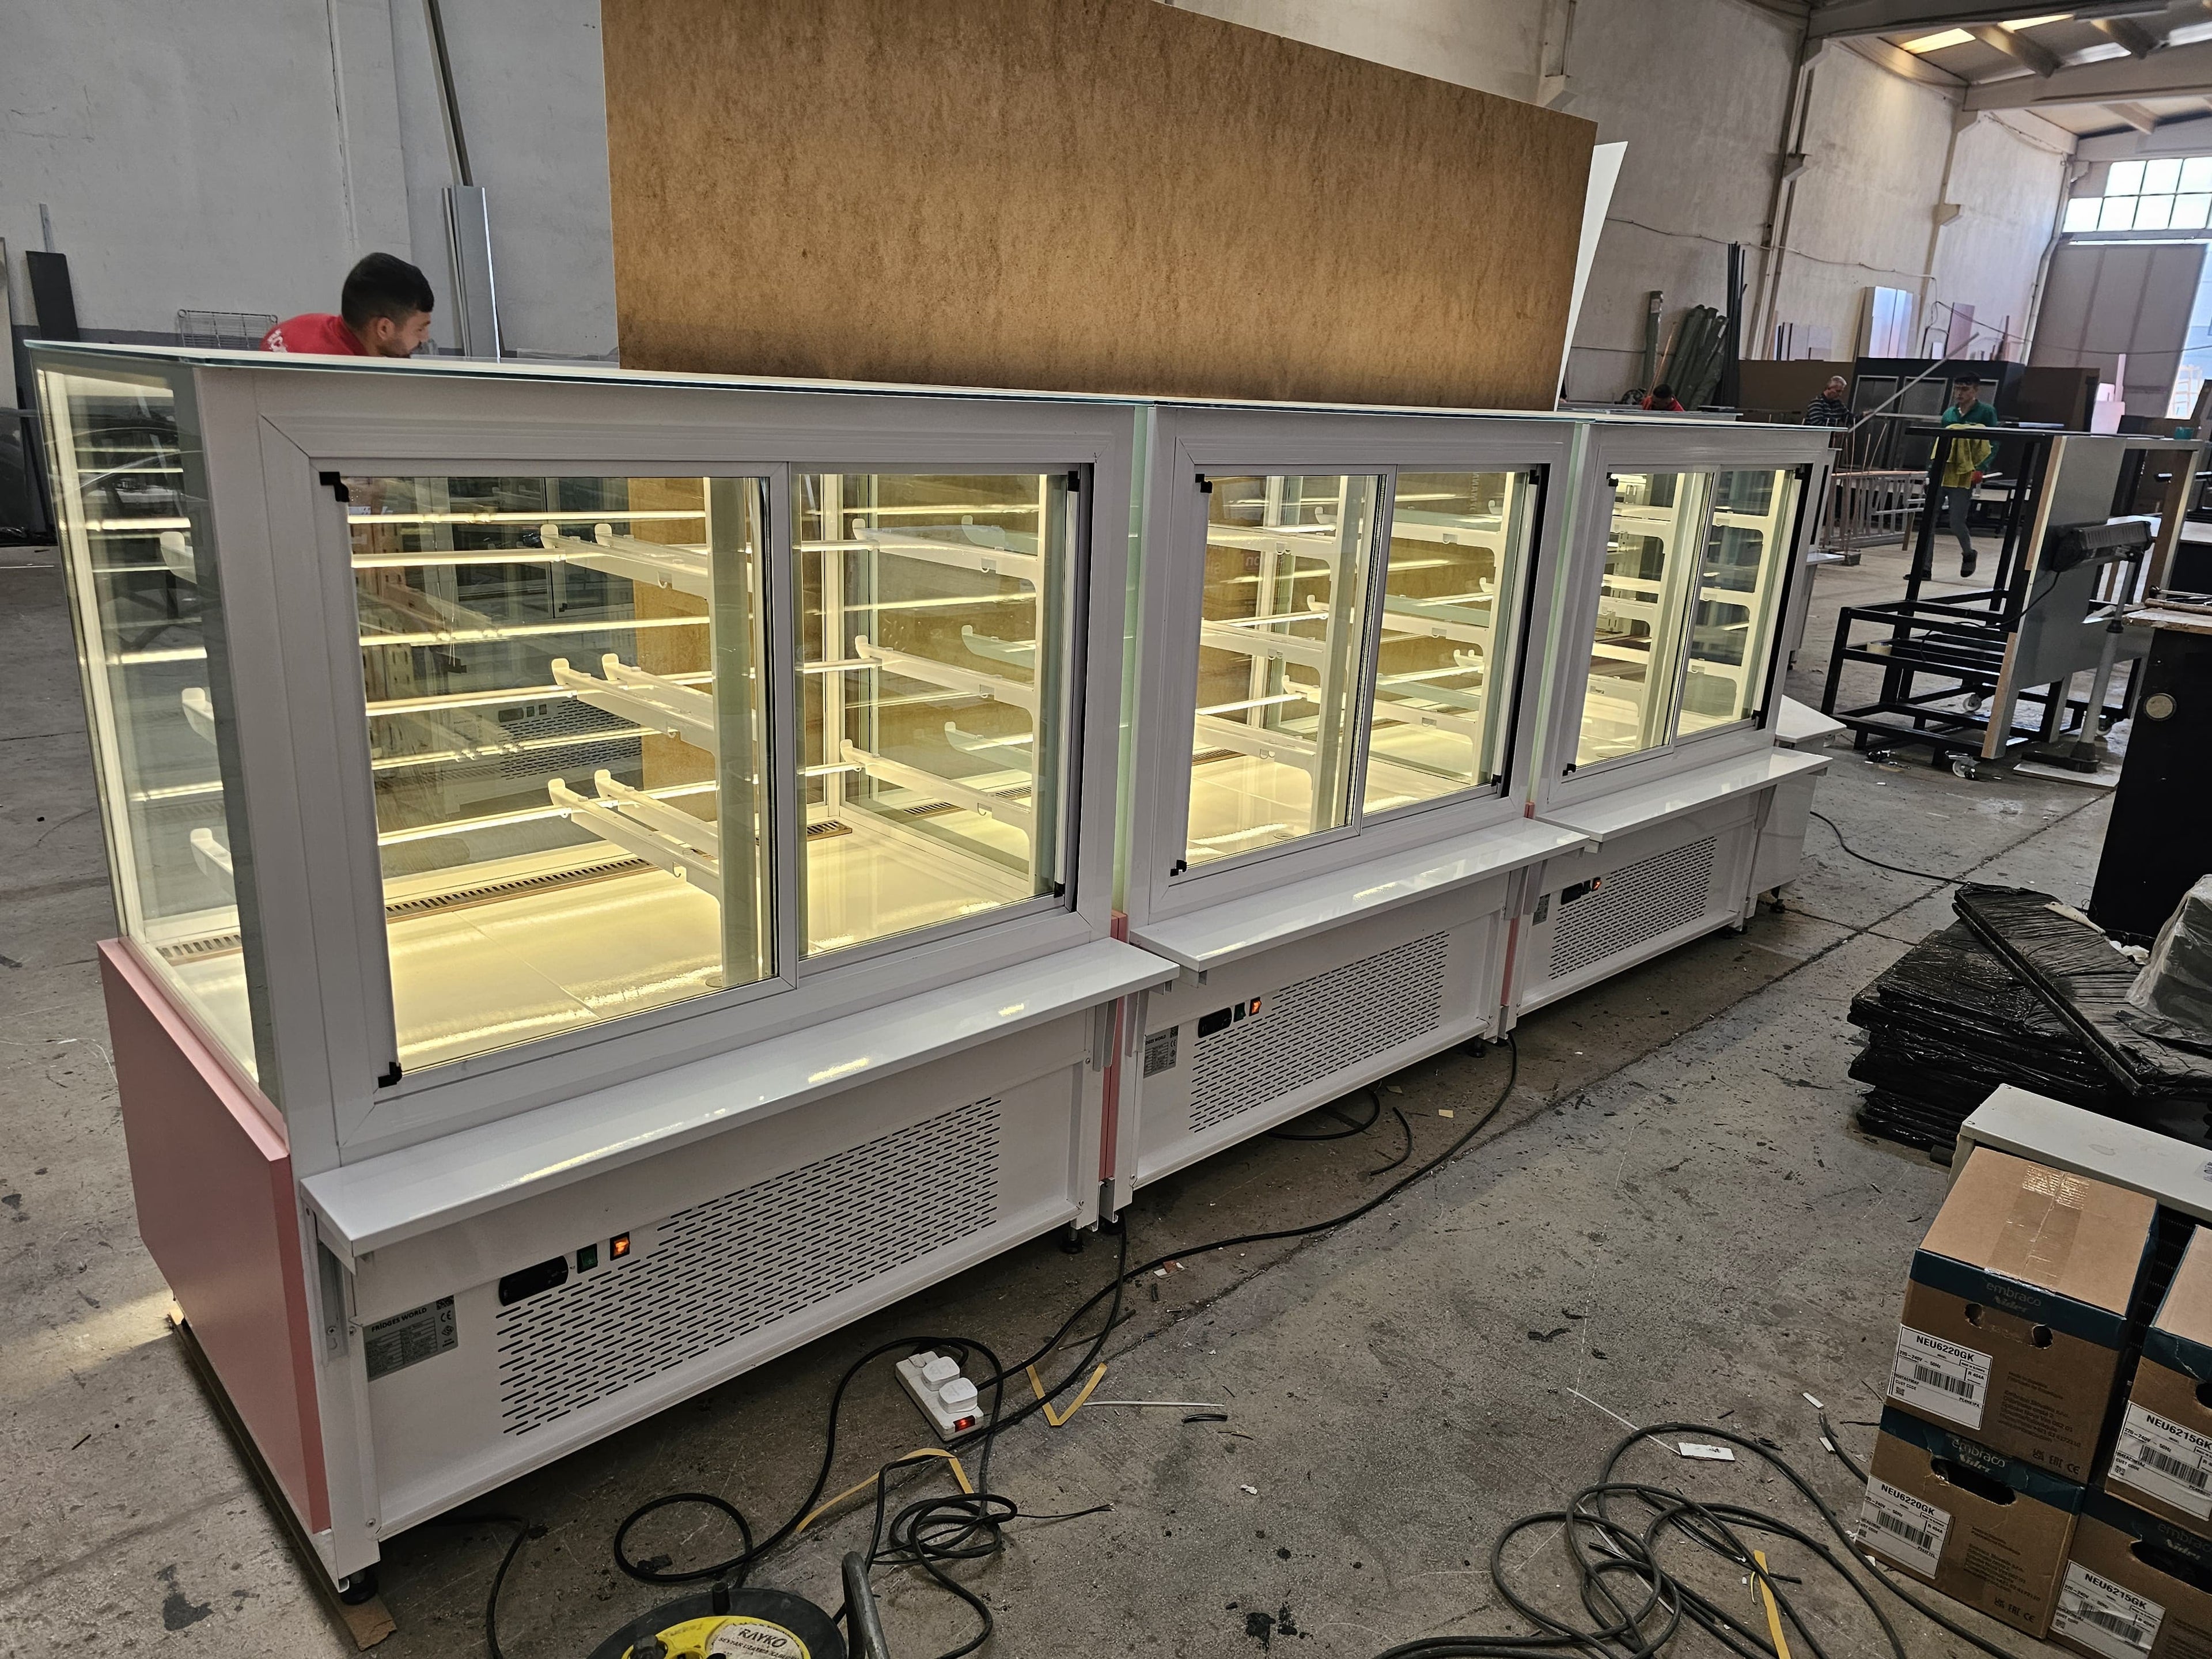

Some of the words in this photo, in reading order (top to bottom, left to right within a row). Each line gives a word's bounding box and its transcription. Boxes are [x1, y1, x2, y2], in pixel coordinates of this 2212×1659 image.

[1986, 1282, 2042, 1306] embraco
[402, 1308, 427, 1321] WORLD
[1916, 1335, 1974, 1362] NEU6220GK
[2146, 1415, 2212, 1450] NEU6215GK
[2159, 1444, 2172, 1452] 50Hz
[2128, 1463, 2139, 1471] CODE
[1881, 1484, 1935, 1516] NEU6220GK
[1932, 1525, 1943, 1534] 404A
[2085, 1573, 2147, 1610] NEU6215GK
[738, 1628, 787, 1648] RAYKO
